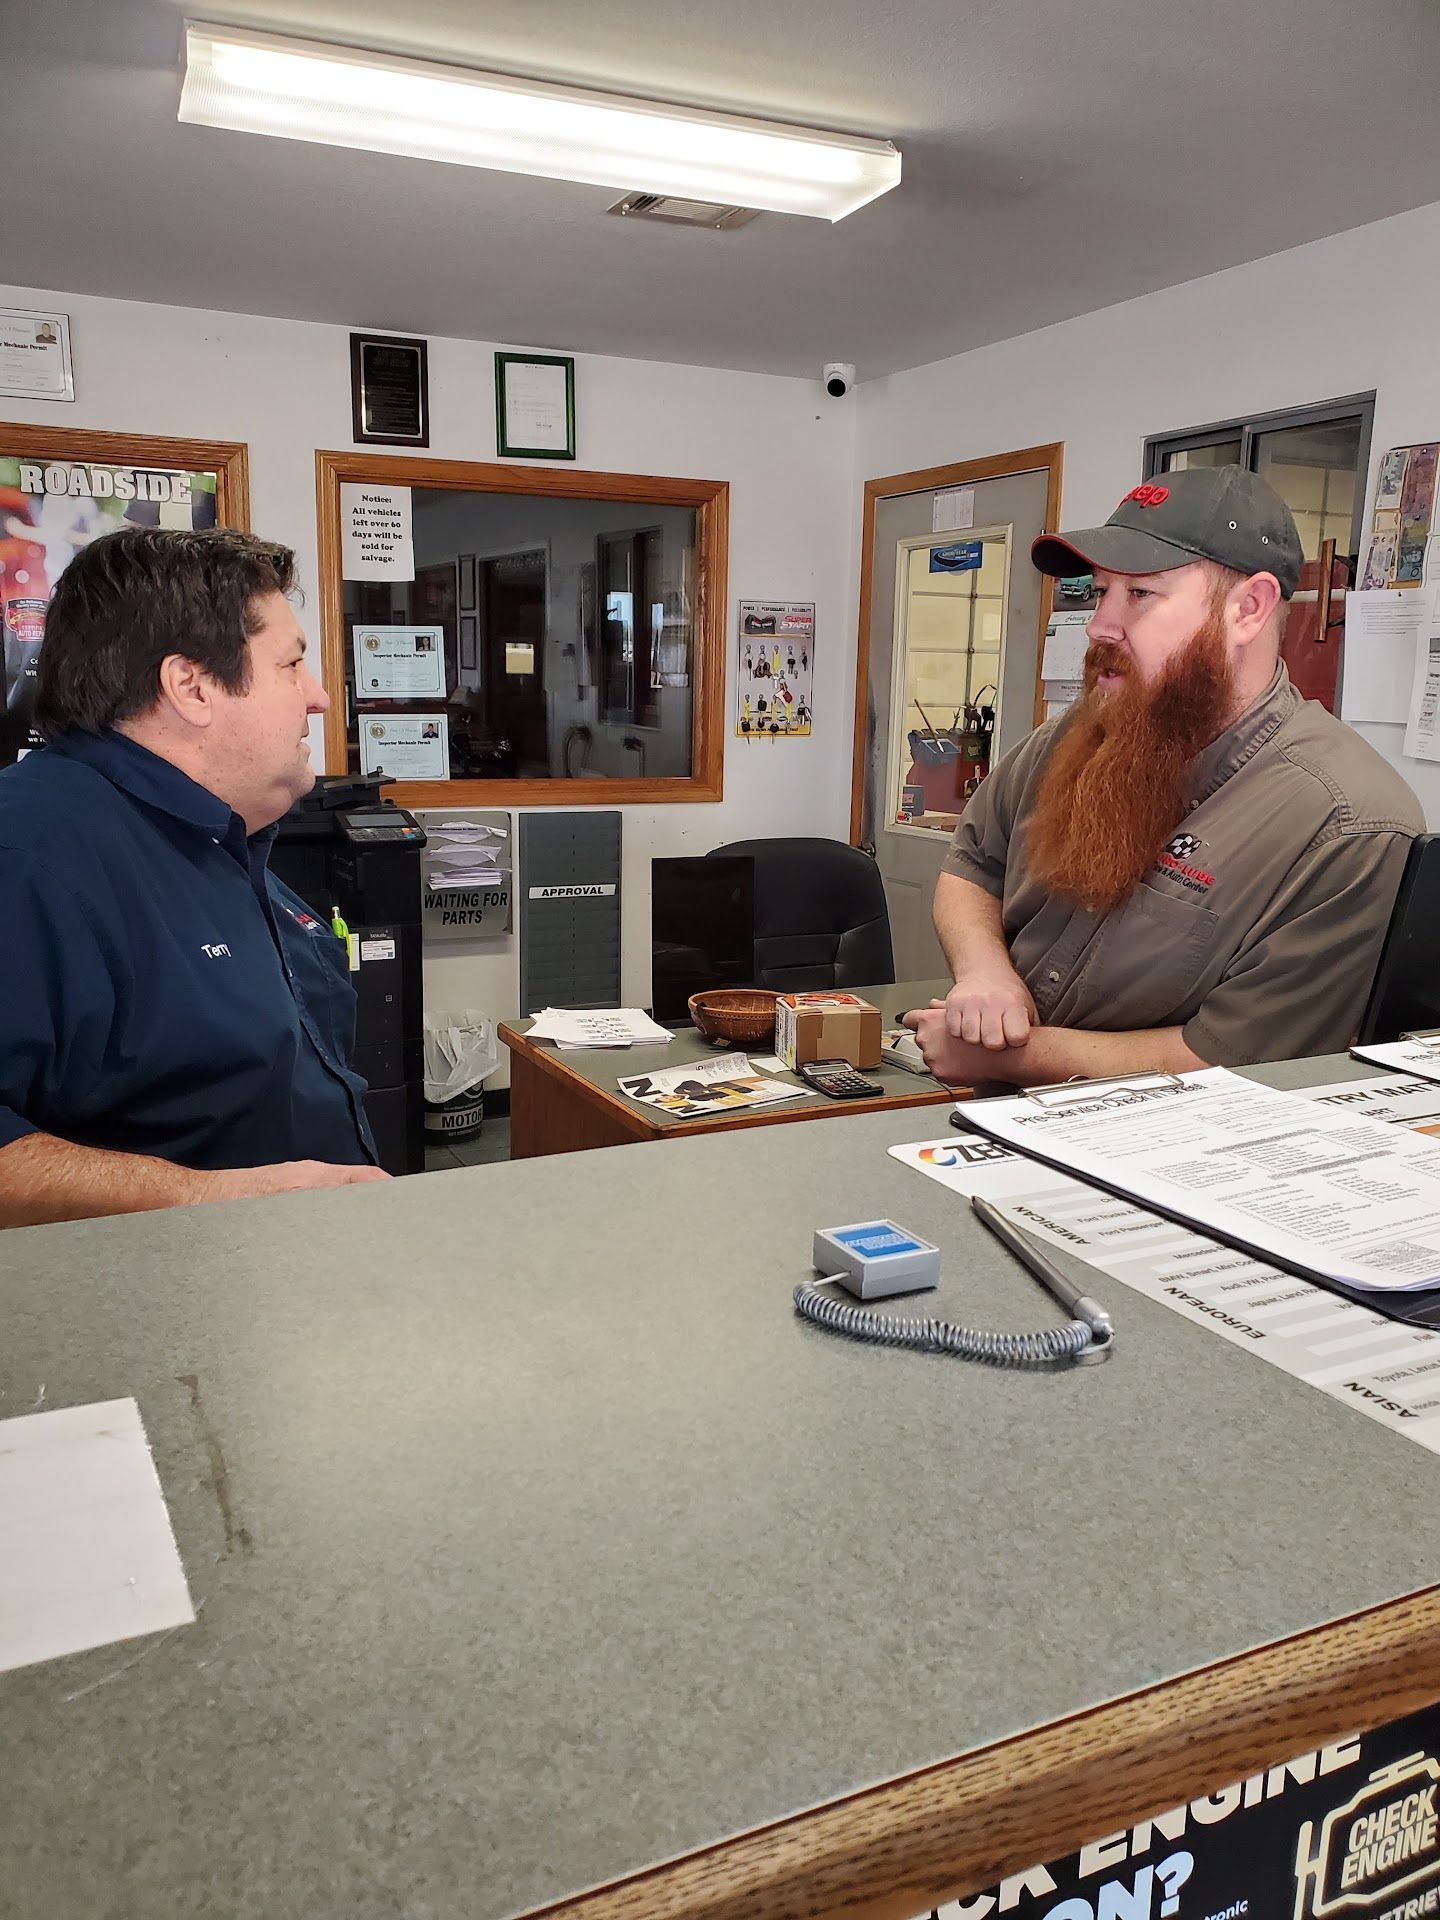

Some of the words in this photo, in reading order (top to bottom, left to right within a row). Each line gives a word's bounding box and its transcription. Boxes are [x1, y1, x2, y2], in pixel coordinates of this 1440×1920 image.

[19, 464, 193, 504] ROADSIDE
[361, 494, 392, 504] Notice:
[352, 507, 366, 515] All
[367, 508, 402, 517] vehicles
[352, 531, 372, 539] days
[392, 532, 403, 540] be
[380, 543, 394, 551] for
[361, 554, 395, 563] salvage.
[541, 886, 604, 897] APPROVAL
[1166, 870, 1184, 884] Auto
[1182, 877, 1209, 894] Center
[424, 893, 479, 909] WAITING
[483, 892, 508, 907] FOR
[442, 909, 483, 926] PARTS
[1011, 1104, 1108, 1126] Pre-Service
[1012, 1206, 1092, 1245] AMERICAN
[1163, 1286, 1267, 1340] EUROPEAN
[1343, 1382, 1420, 1418] ASIAN
[1348, 1783, 1438, 1854] CHECK
[1340, 1813, 1439, 1890] ENGINE
